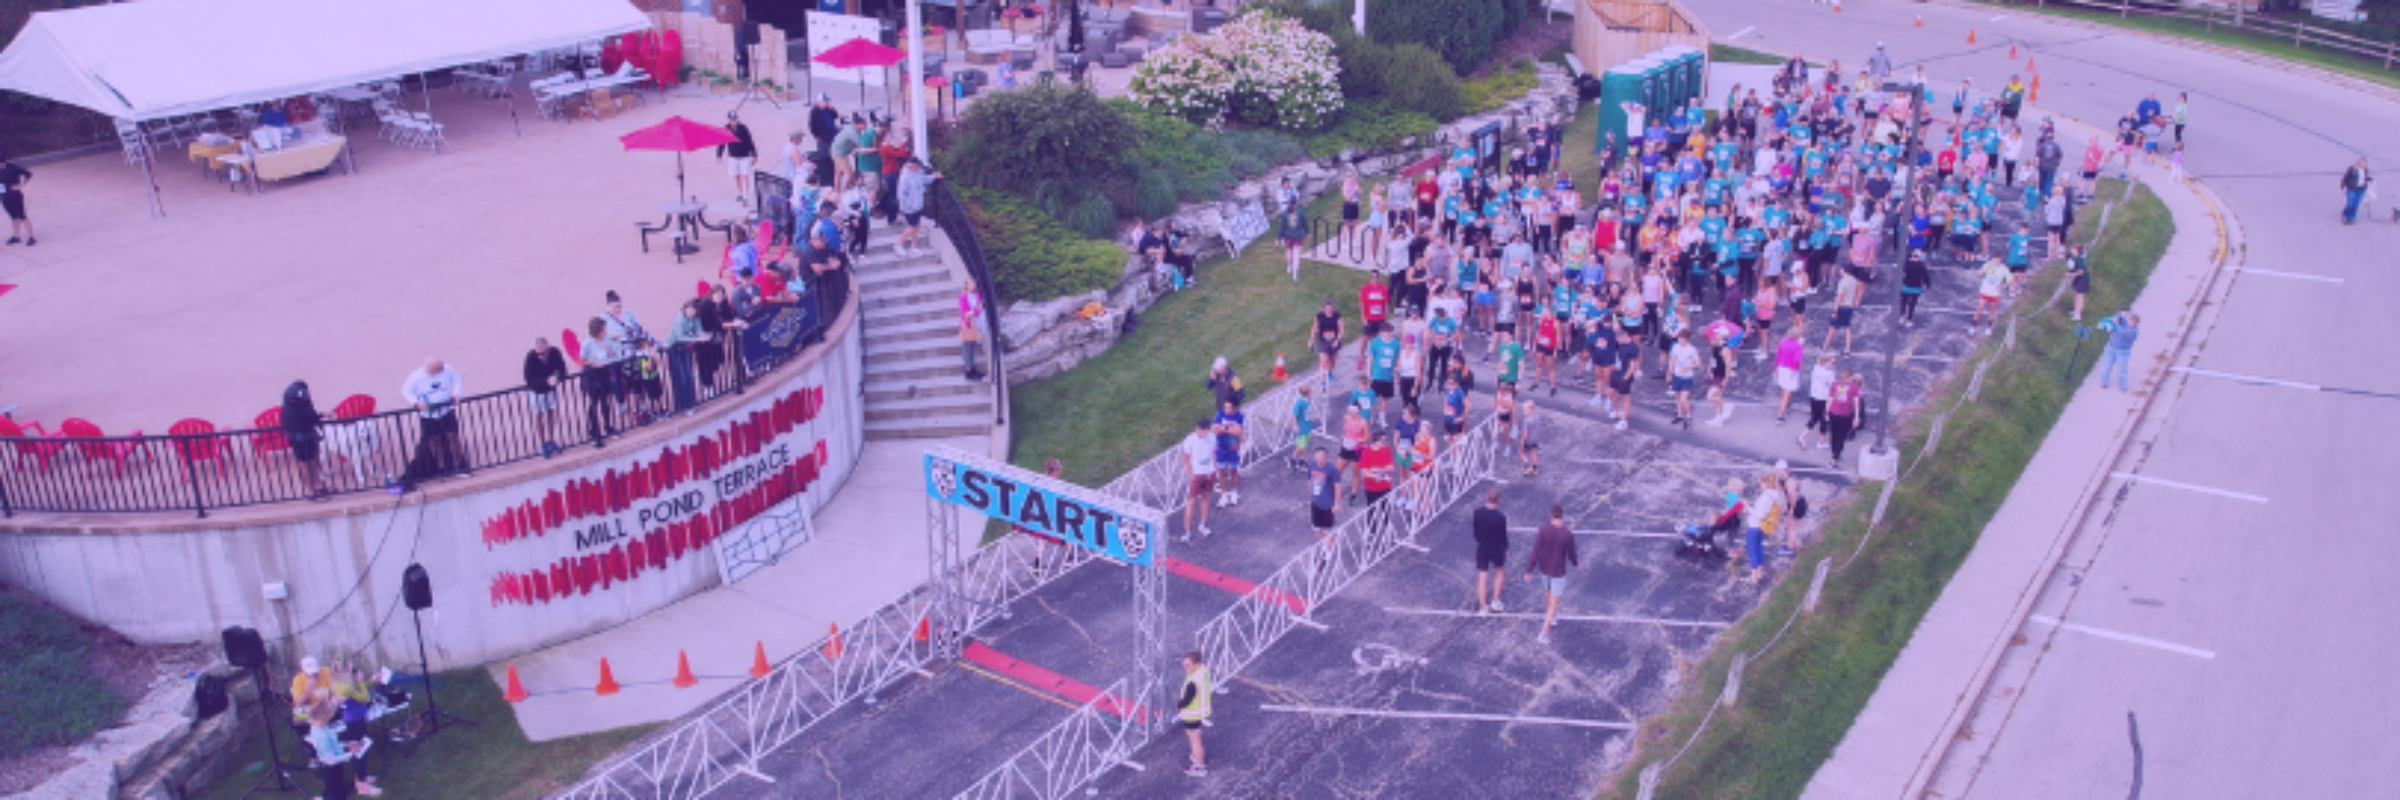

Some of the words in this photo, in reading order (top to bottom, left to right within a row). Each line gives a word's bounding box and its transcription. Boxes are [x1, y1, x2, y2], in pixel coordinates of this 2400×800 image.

[576, 518, 626, 550] MILL
[640, 490, 704, 529] POND
[713, 444, 789, 499] TERRACE
[962, 469, 1113, 547] START
